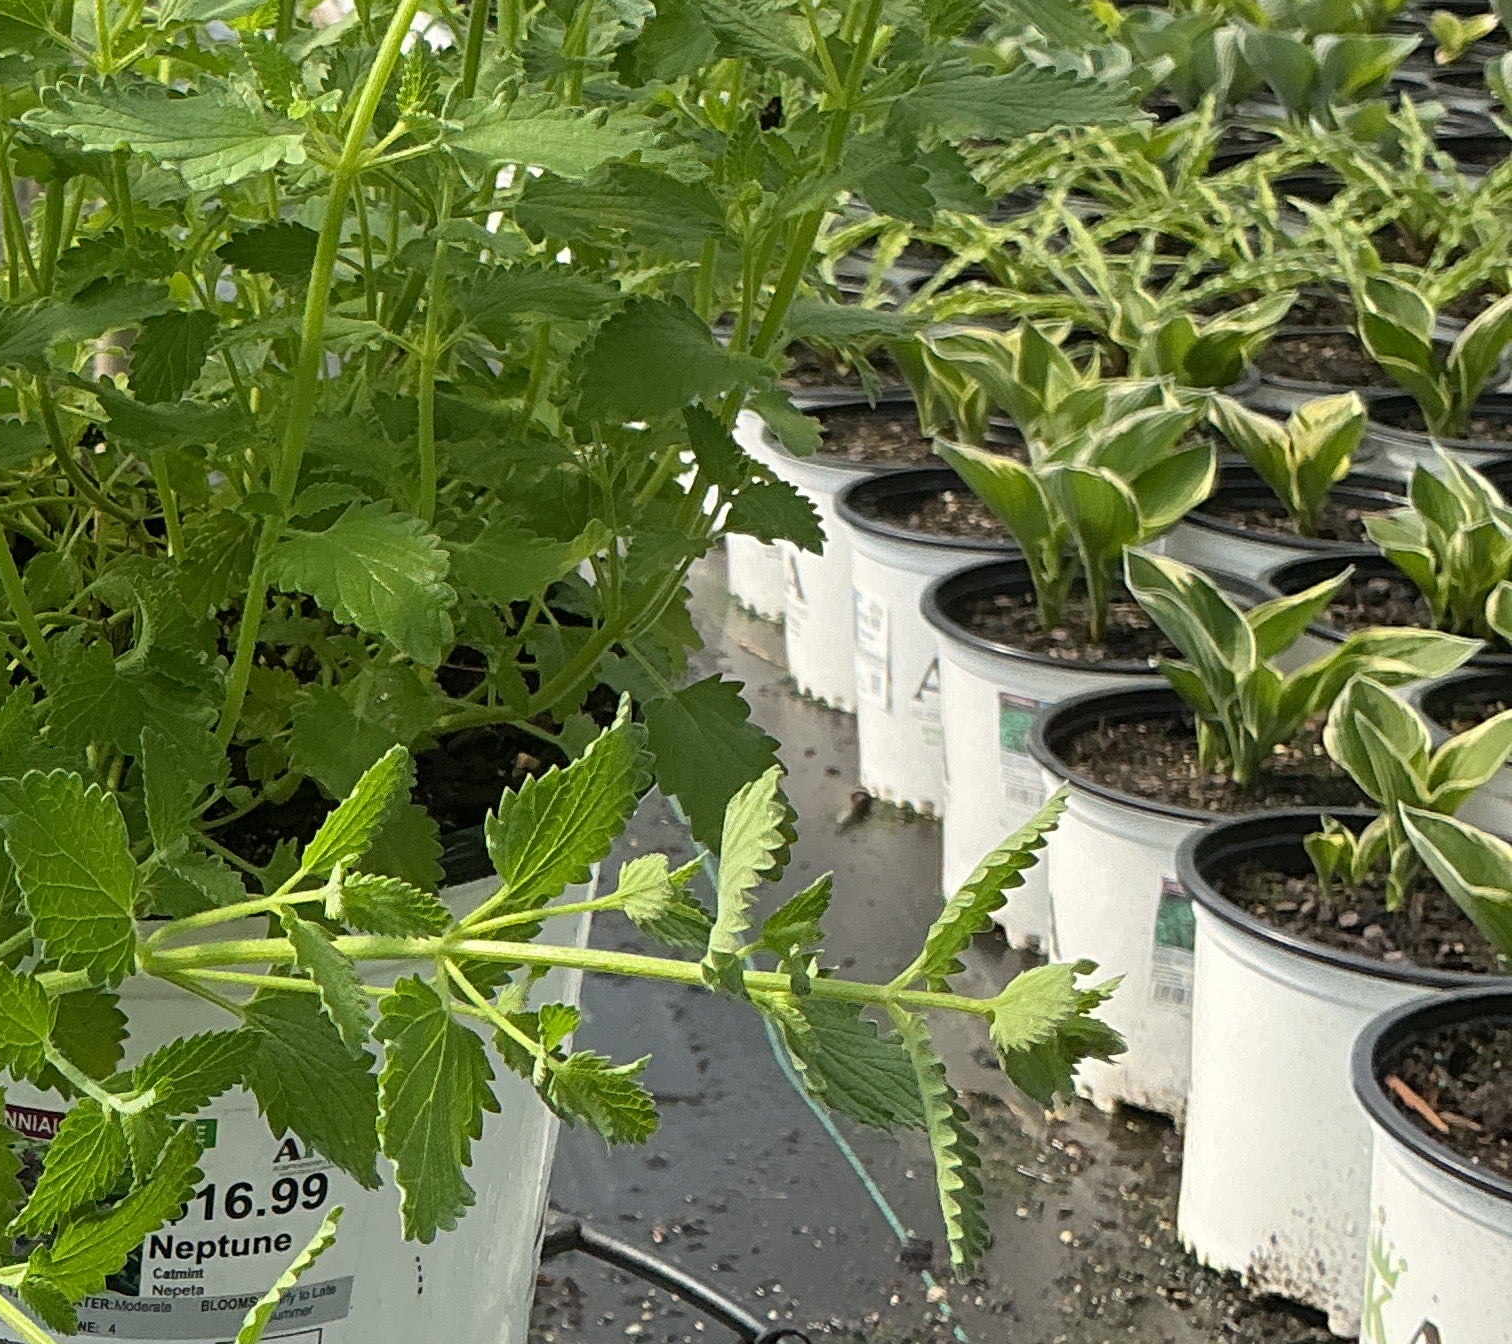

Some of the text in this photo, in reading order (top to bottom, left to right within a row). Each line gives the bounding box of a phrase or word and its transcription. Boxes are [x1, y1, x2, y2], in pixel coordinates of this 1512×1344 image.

[149, 1232, 292, 1264] Neptune
[152, 1266, 205, 1280] Catmint
[151, 1283, 205, 1299] Nepeta
[312, 1284, 337, 1299] Late
